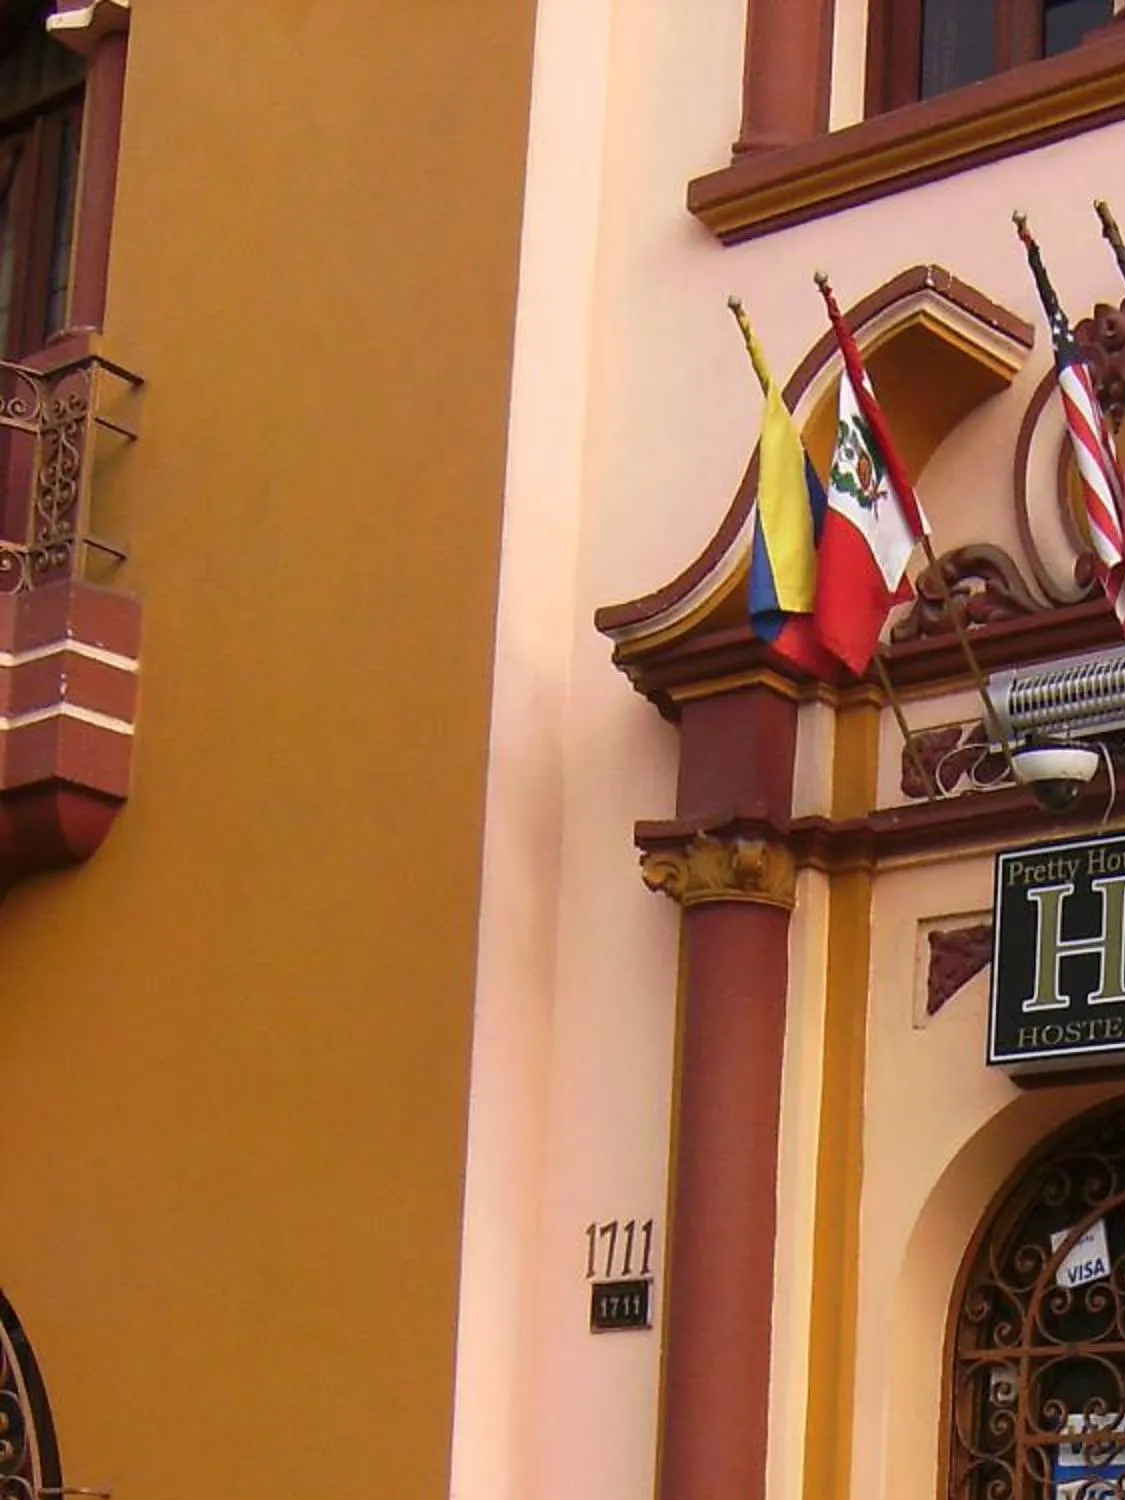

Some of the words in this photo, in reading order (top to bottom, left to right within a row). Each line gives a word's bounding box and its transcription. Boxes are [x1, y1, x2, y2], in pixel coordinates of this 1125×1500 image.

[1007, 857, 1080, 886] Pretty
[585, 1219, 653, 1278] 1711
[1067, 1256, 1105, 1283] VISA
[601, 1295, 641, 1318] 1711
